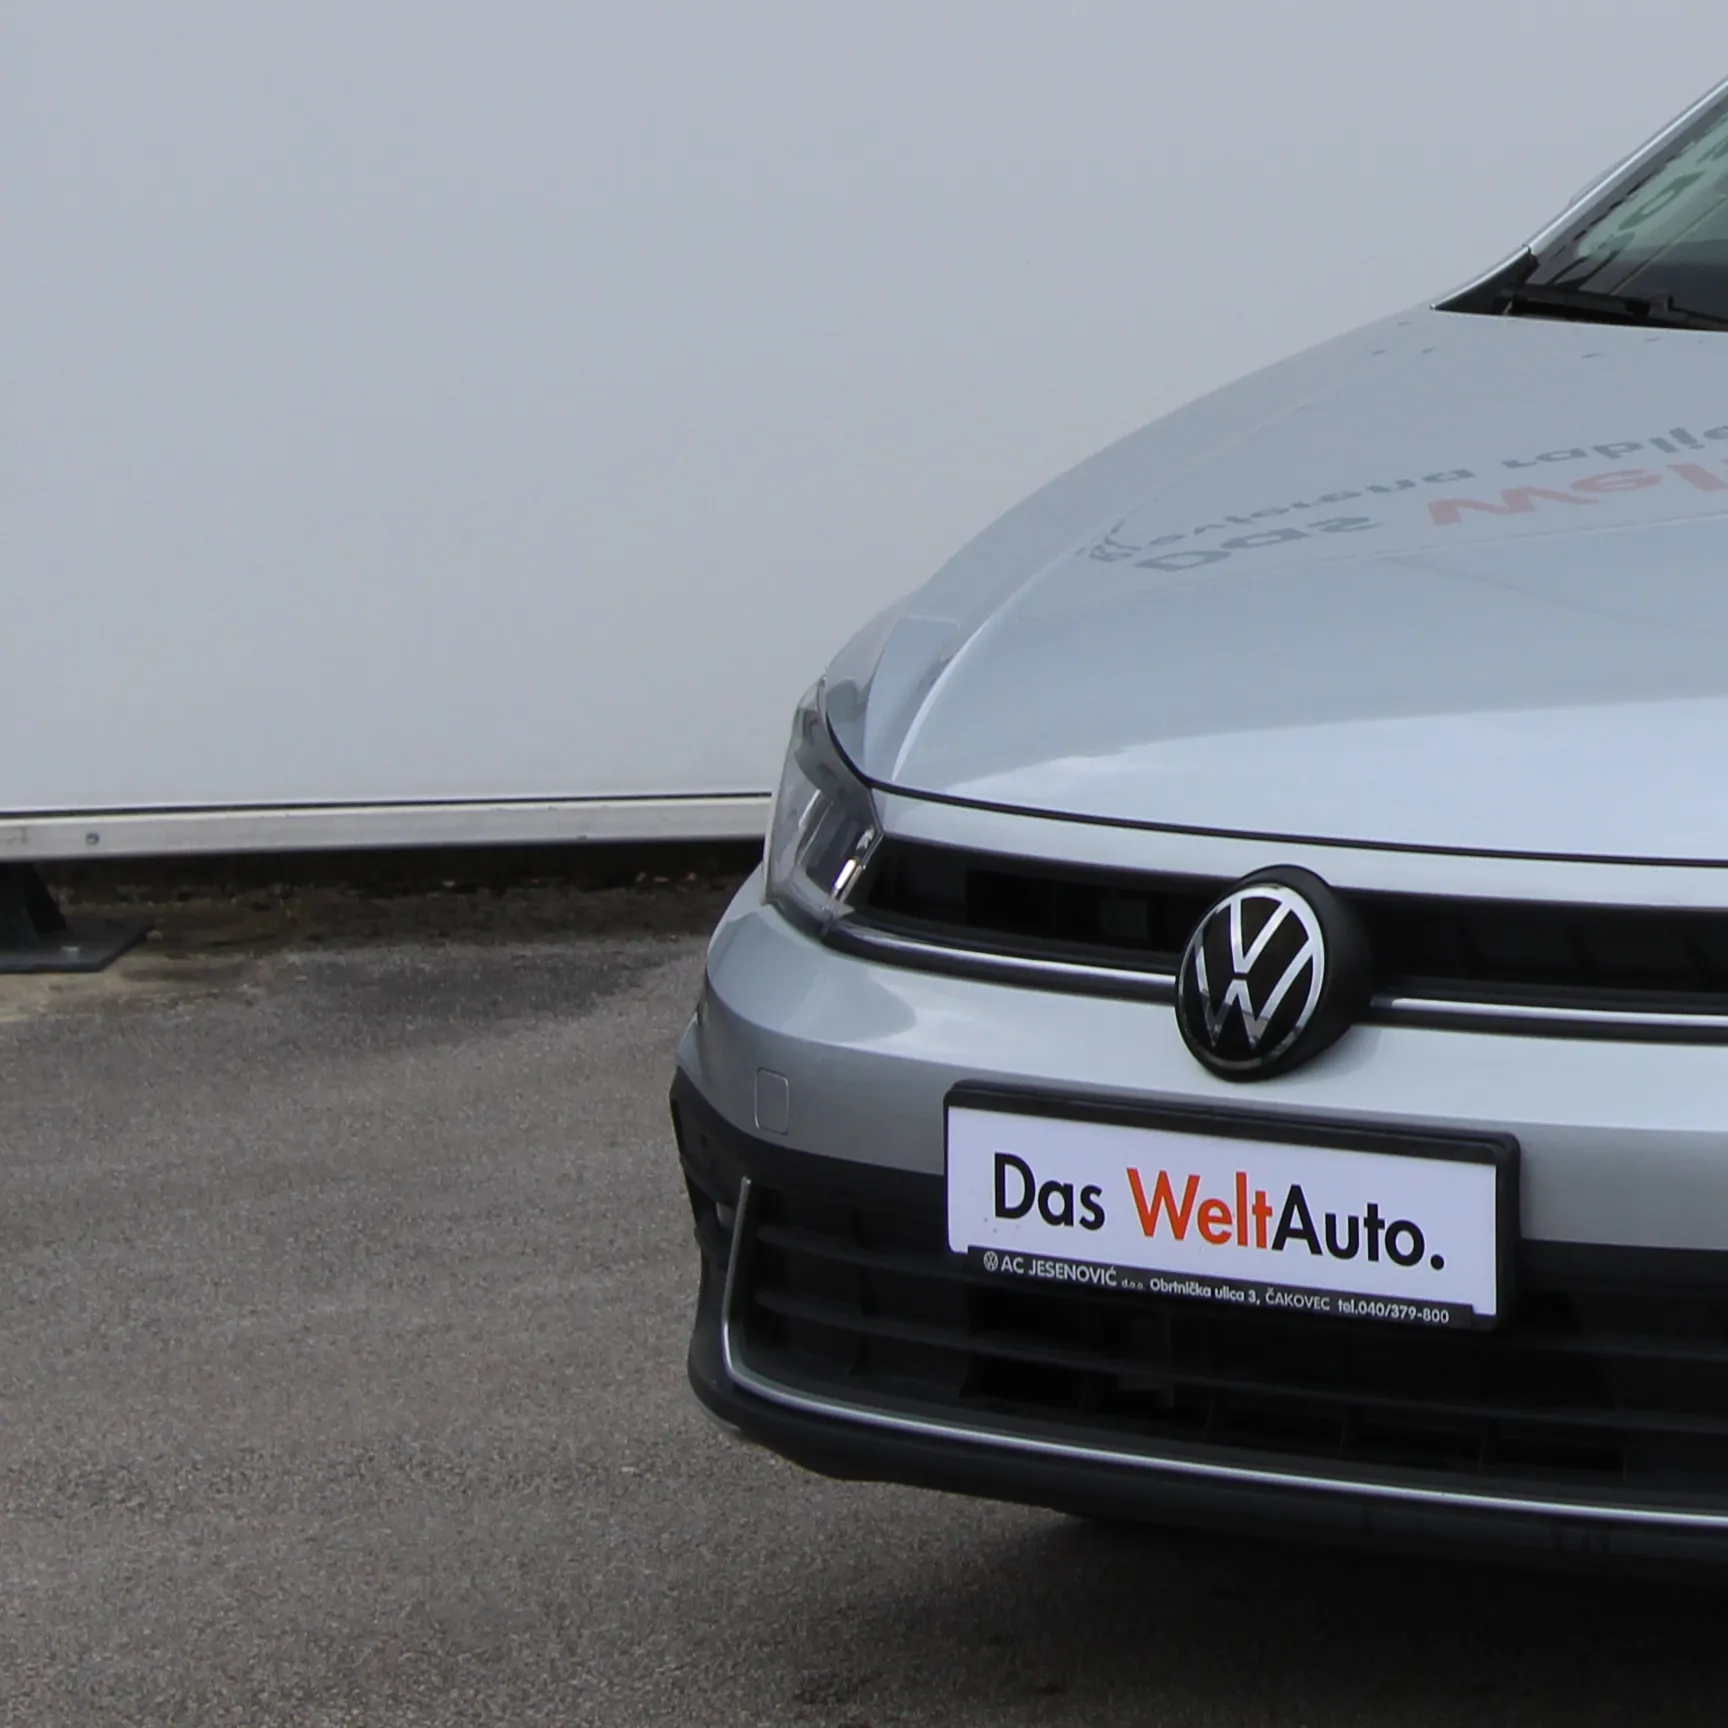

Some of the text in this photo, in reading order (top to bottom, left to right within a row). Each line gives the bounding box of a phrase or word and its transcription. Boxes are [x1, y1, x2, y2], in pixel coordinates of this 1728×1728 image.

[993, 1151, 1446, 1272] Das WeltAuto.
[1000, 1255, 1025, 1274] AC
[1028, 1259, 1118, 1287] JESENOVIĆ
[1149, 1278, 1212, 1299] Obrtnička
[1214, 1286, 1245, 1302] ulica
[1265, 1287, 1331, 1311] ČAKOVEC
